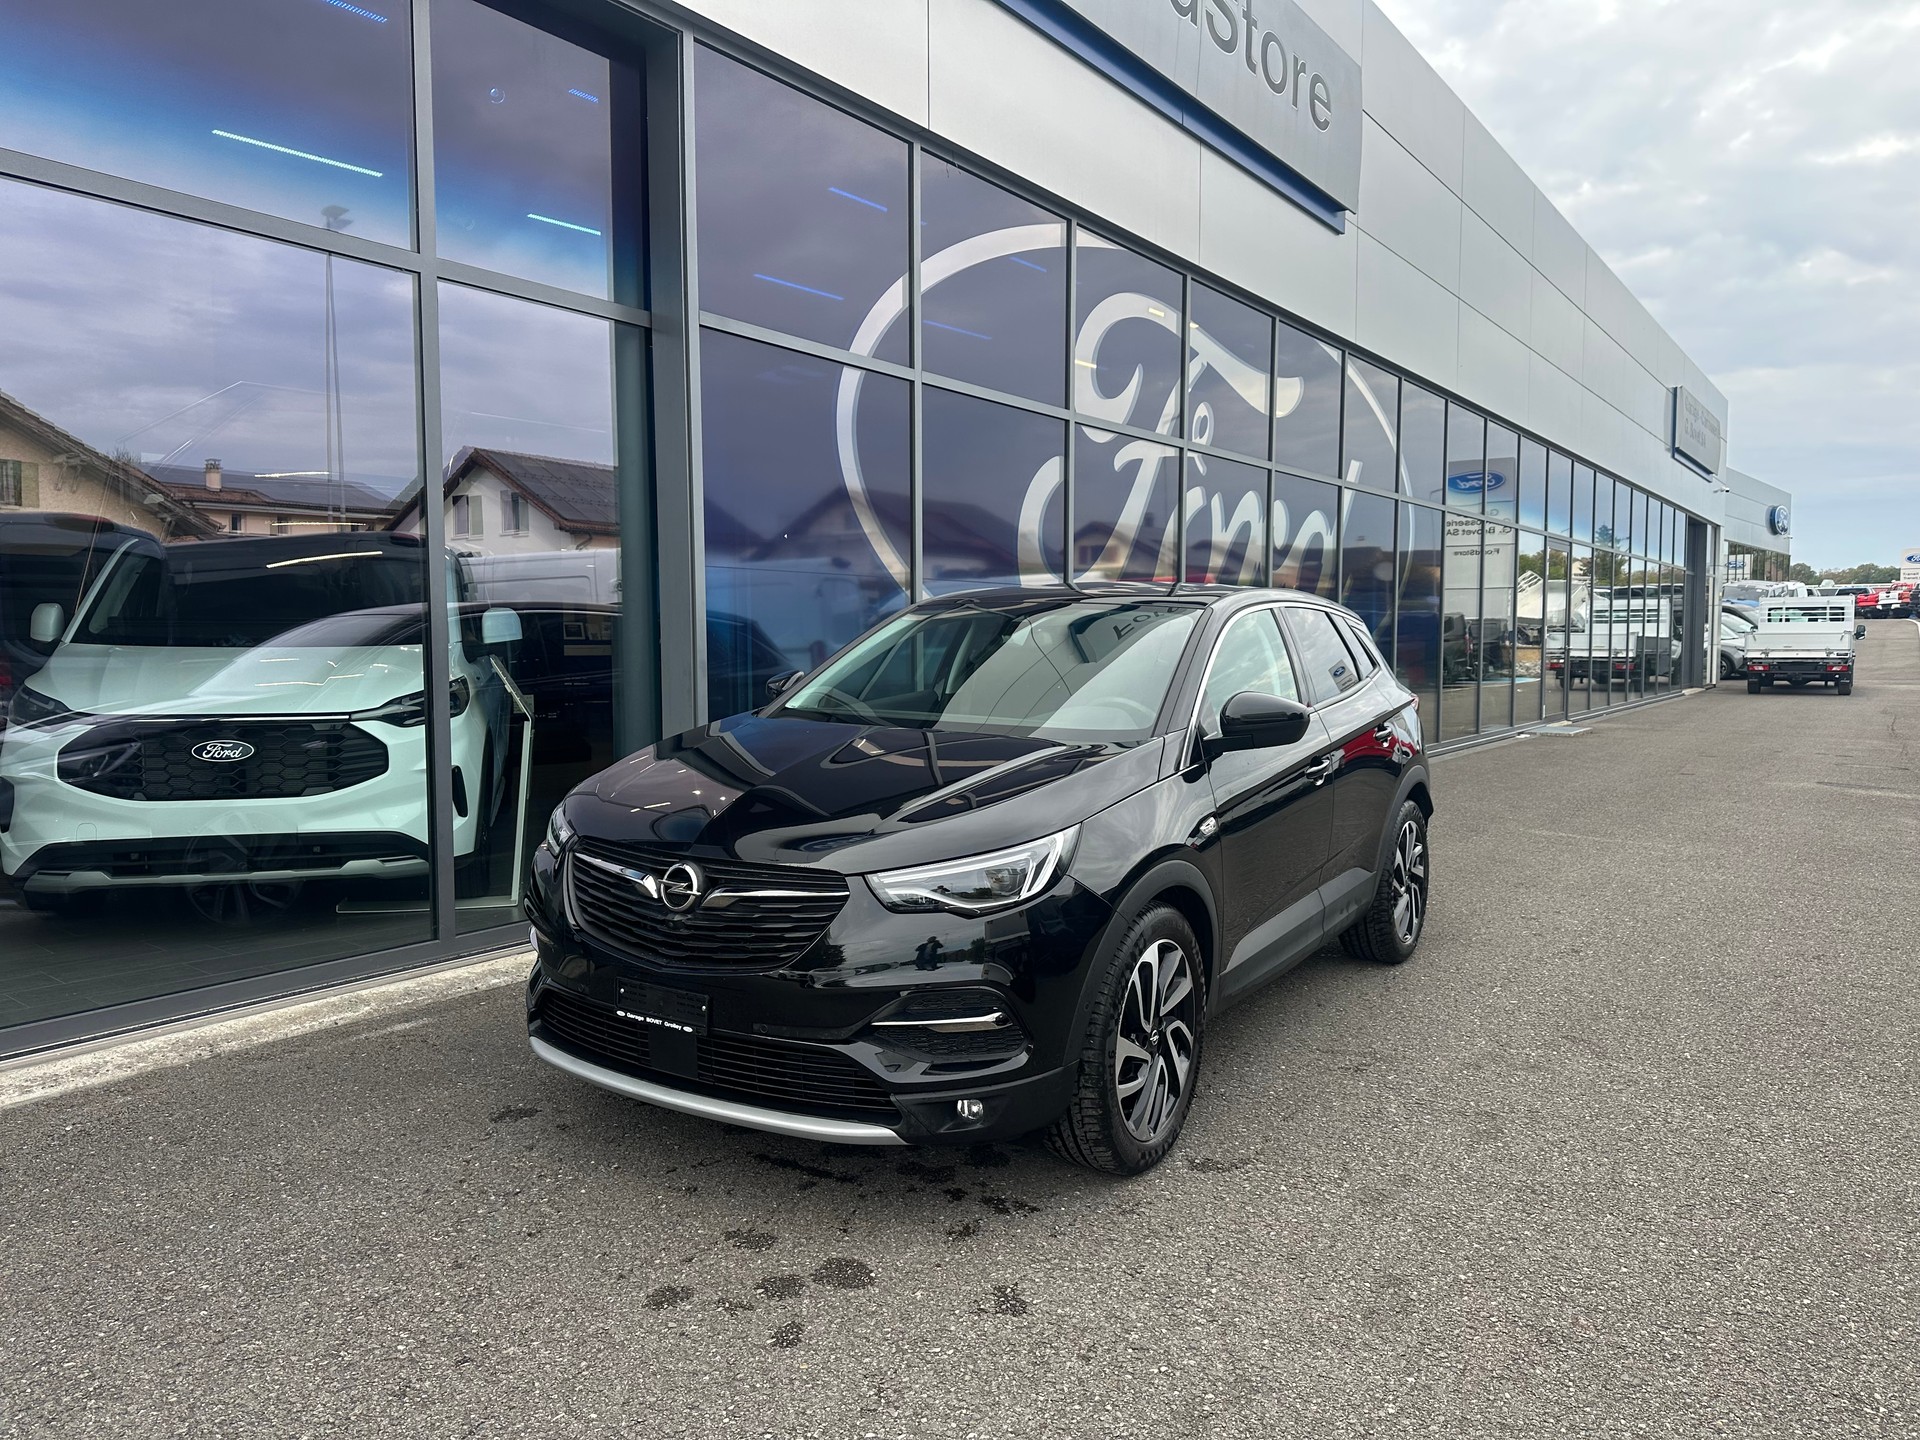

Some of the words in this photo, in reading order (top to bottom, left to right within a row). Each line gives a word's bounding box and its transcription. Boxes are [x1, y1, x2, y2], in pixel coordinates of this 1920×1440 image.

[202, 743, 243, 758] Ford
[626, 1012, 644, 1021] Garage
[646, 1017, 662, 1025] BOVET
